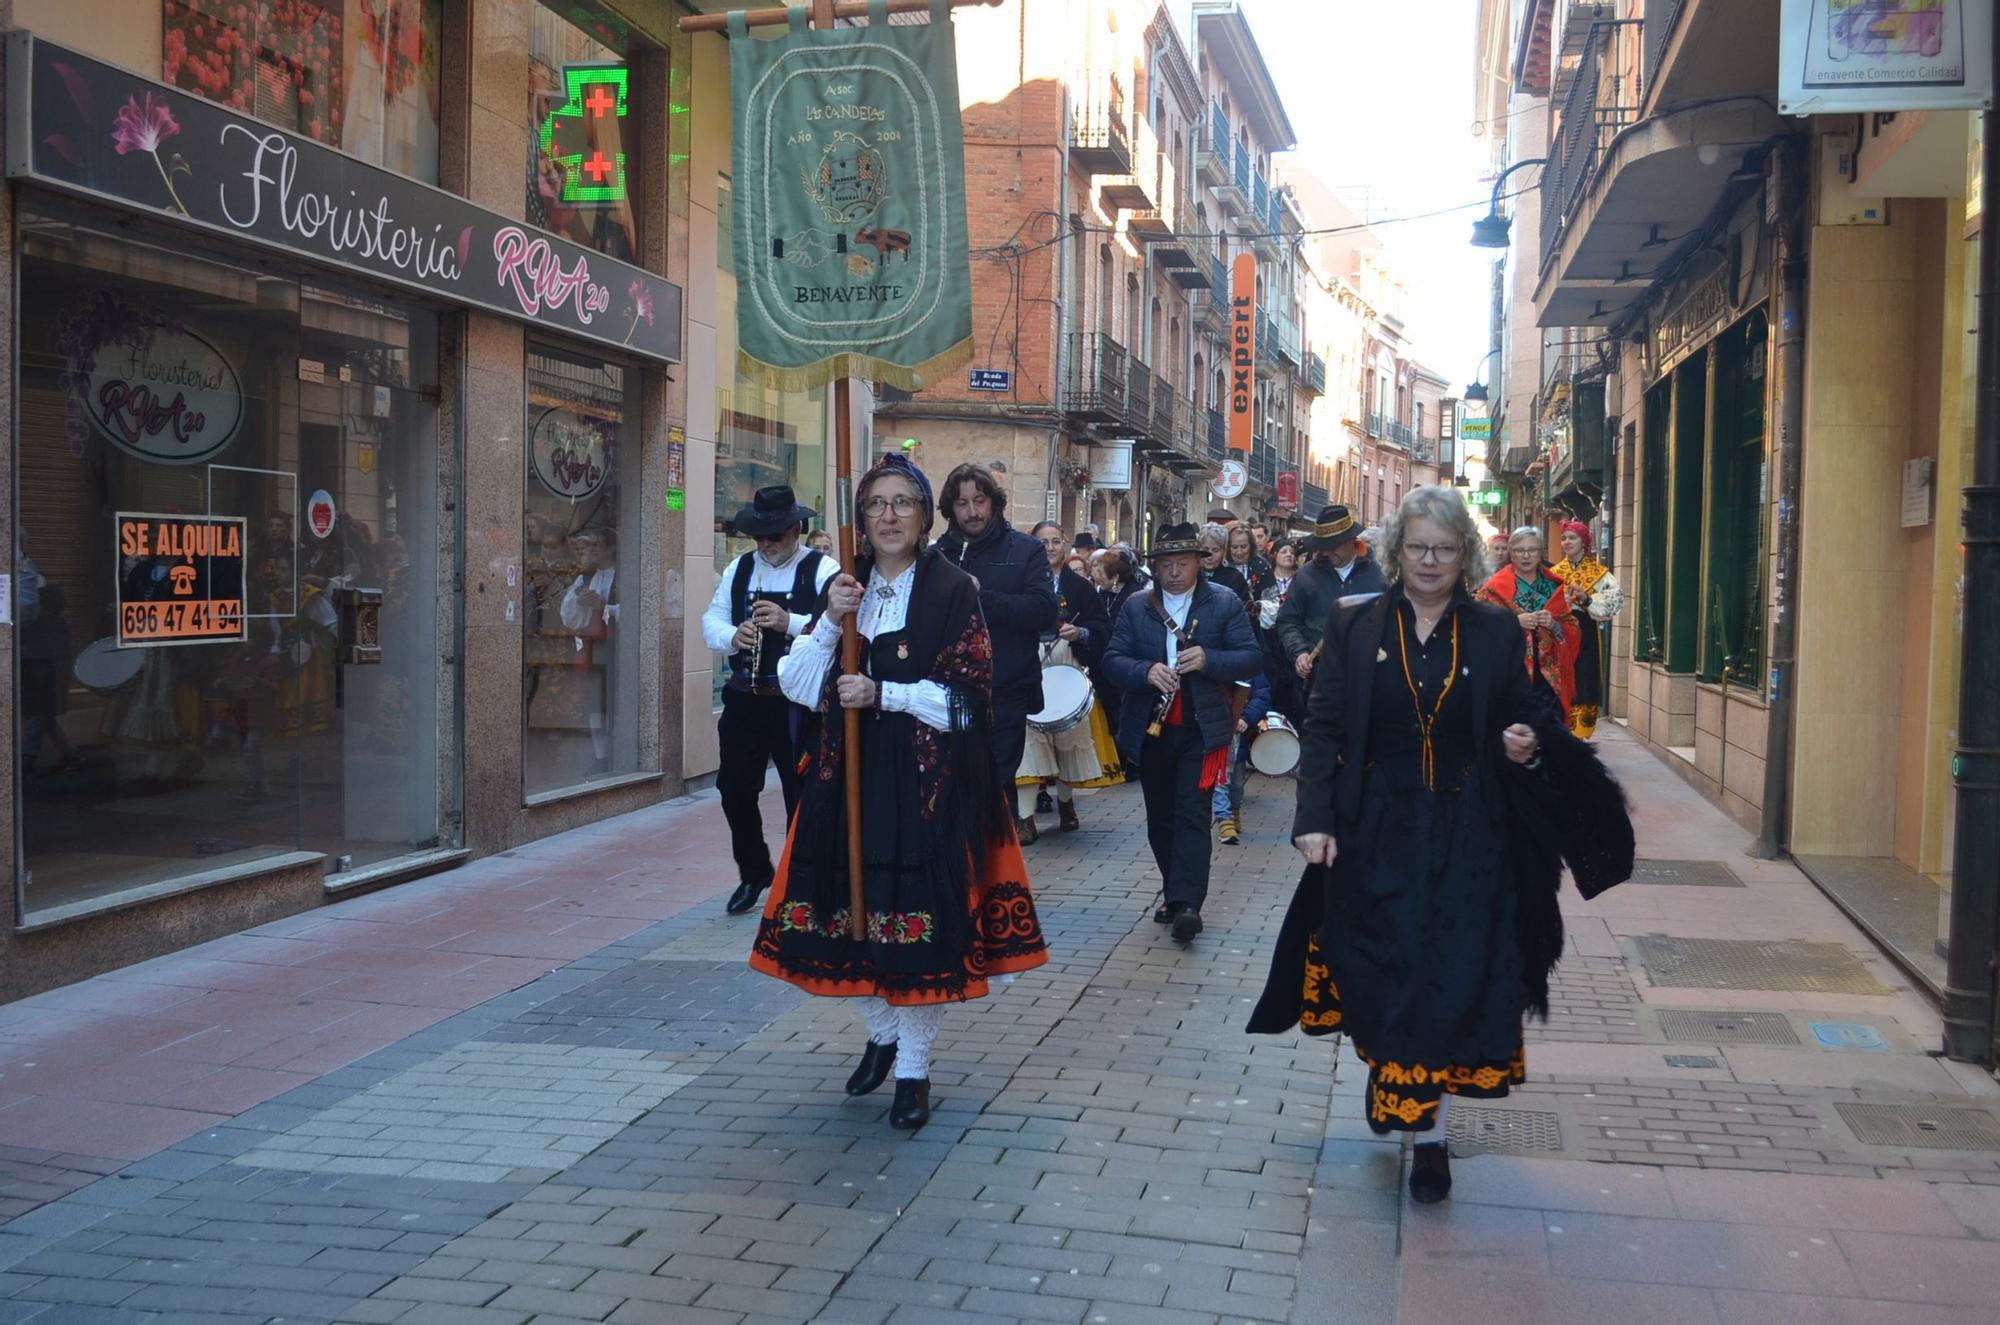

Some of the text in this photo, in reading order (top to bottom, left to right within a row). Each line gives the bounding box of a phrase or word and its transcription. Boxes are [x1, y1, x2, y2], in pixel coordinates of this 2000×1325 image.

[1867, 66, 1915, 80] Comercio
[1918, 65, 1958, 79] Calidad
[825, 104, 886, 122] CANDELAS
[787, 131, 813, 145] AÑO
[220, 123, 463, 281] Floristería
[585, 283, 610, 313] 20
[793, 285, 904, 303] BENAVENTE
[1233, 296, 1252, 414] expert
[182, 411, 206, 433] 20
[121, 521, 241, 565] SE ALQUILA
[124, 602, 239, 634] 696 47 41 94
